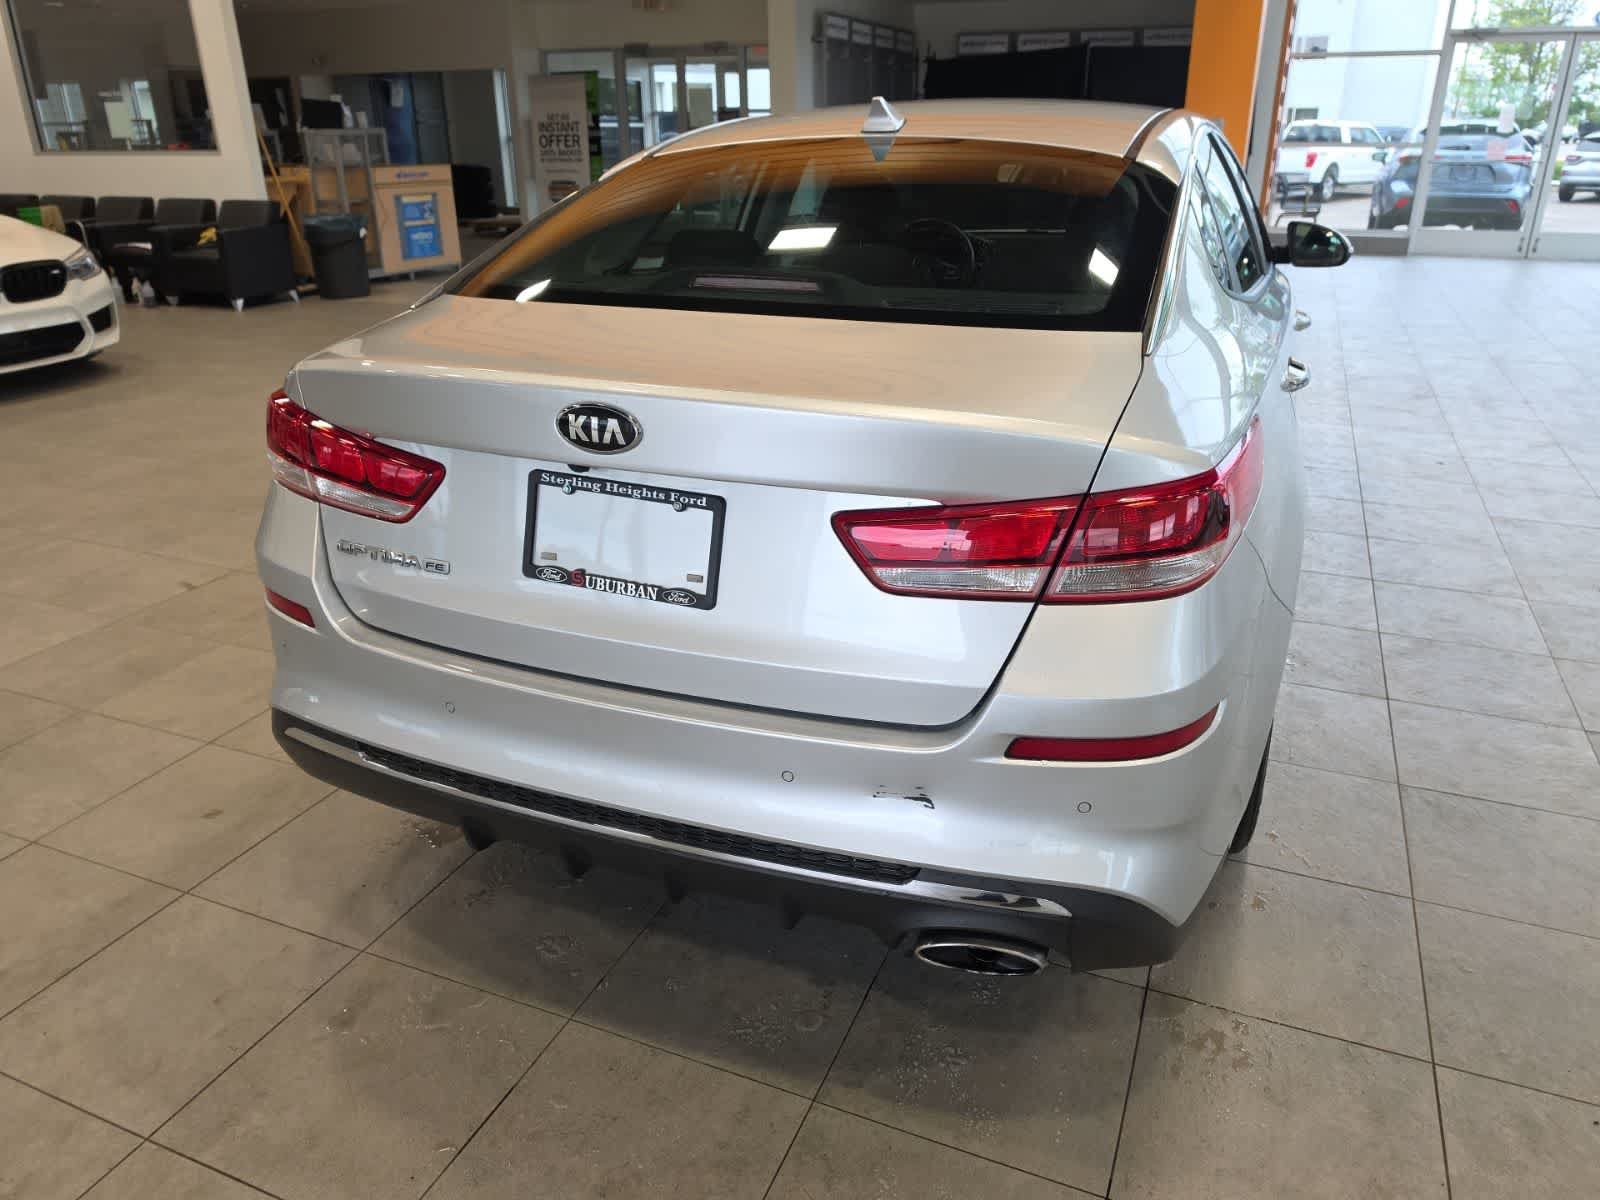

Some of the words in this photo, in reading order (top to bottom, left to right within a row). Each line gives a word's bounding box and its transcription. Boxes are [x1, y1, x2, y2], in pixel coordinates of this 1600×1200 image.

[538, 121, 580, 133] INSTANT
[539, 134, 580, 149] OFFER
[568, 413, 627, 446] KIA
[541, 472, 602, 493] Sterling
[605, 482, 666, 500] Heights
[670, 492, 707, 507] Ford
[425, 561, 445, 572] FE
[539, 568, 562, 582] Ford
[570, 569, 659, 601] SUBURBAN
[665, 591, 691, 605] Ford
